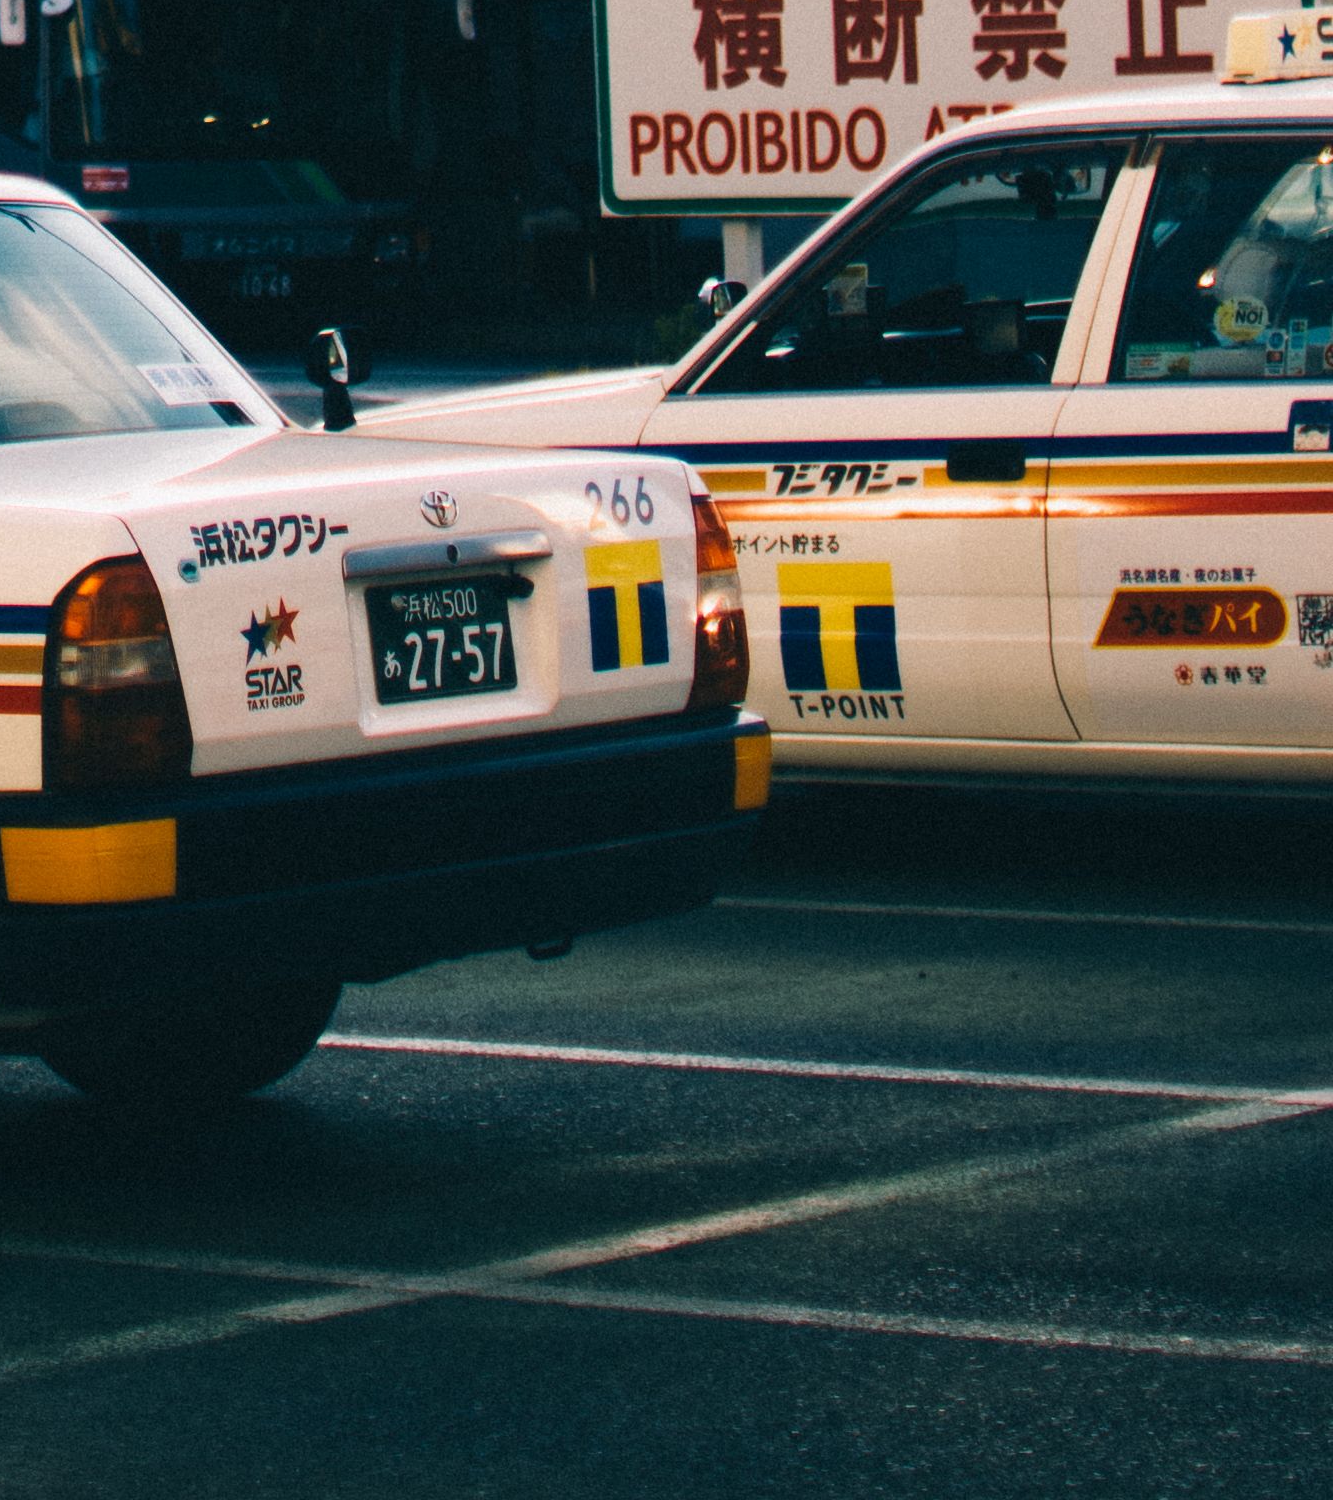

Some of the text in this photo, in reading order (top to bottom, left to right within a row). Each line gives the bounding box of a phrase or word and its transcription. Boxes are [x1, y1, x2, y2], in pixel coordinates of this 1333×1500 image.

[630, 106, 887, 177] PROIBIDO
[773, 464, 918, 496] フジタクシー
[583, 476, 655, 531] 266
[189, 514, 351, 569] 浜松タクシー
[1123, 601, 1262, 637] うなぎパイ
[383, 622, 506, 693] あ 27-57
[245, 664, 304, 699] STAR
[246, 693, 306, 712] TAXI GROUP
[790, 695, 906, 721] T-POINT
